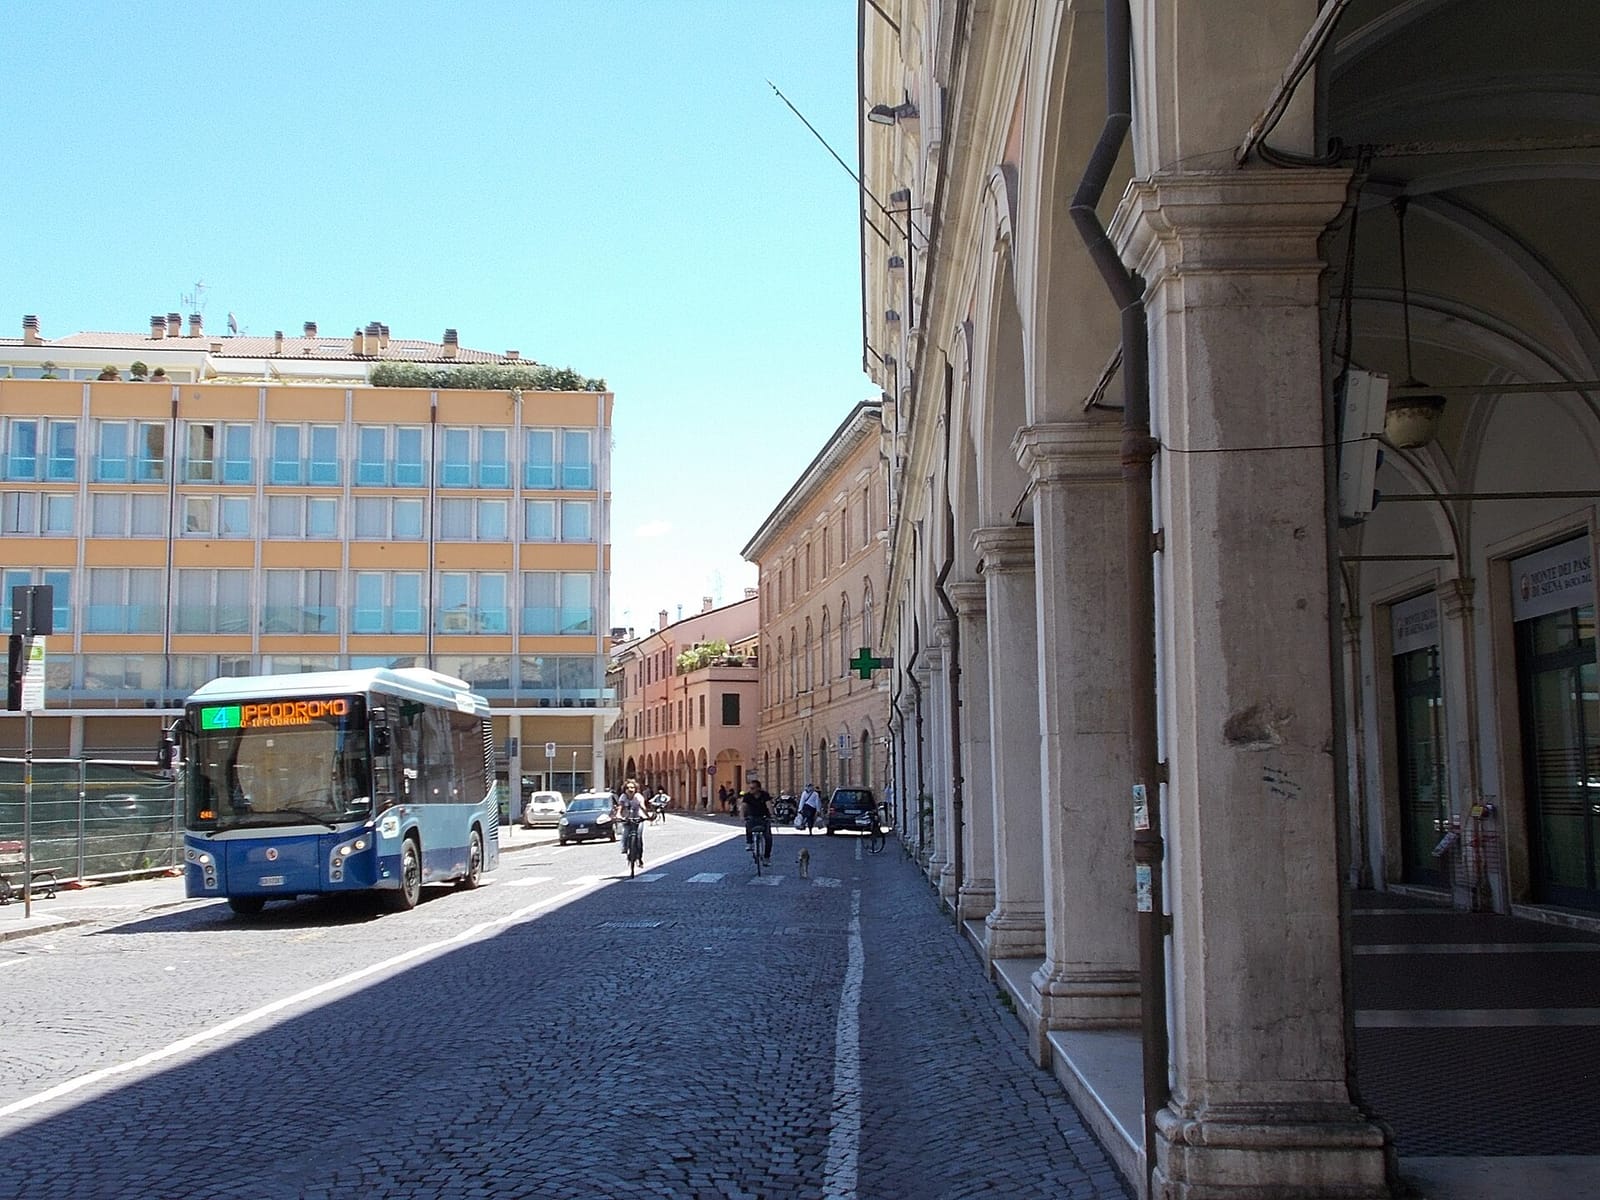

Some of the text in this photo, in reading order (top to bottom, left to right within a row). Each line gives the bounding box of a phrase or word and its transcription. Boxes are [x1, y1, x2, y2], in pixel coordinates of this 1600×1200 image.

[1530, 566, 1557, 584] MONTE
[1558, 562, 1571, 577] DEI
[1541, 580, 1563, 595] SIENA
[213, 699, 345, 728] 4 IPPODROMO
